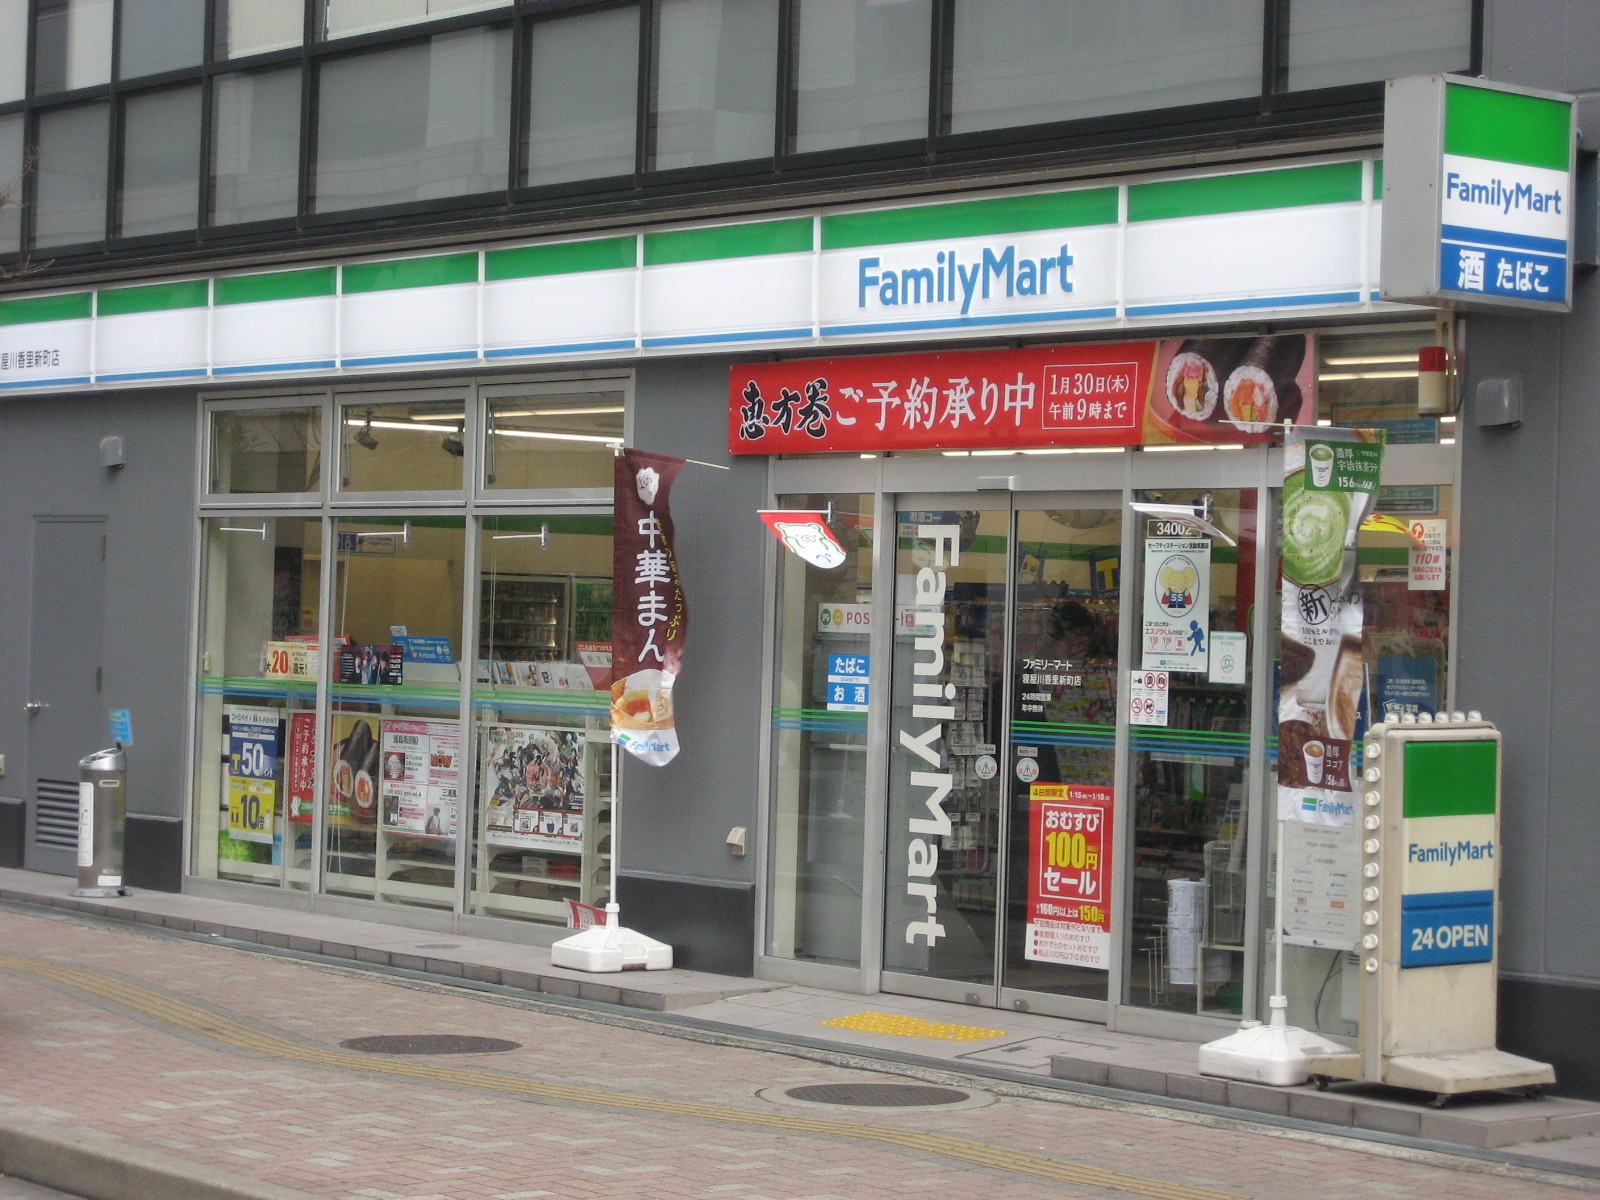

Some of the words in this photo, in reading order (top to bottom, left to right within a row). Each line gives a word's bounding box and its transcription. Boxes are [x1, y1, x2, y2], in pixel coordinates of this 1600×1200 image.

[1447, 172, 1561, 215] FamilyMart
[859, 243, 1074, 315] FamilyMart
[1458, 249, 1486, 291] 酒
[1496, 258, 1549, 292] たばこ
[1050, 373, 1131, 396] 1月30日(木)
[1049, 400, 1128, 421] 午前9時まで
[1338, 476, 1355, 488] 156
[634, 510, 671, 663] 中華まん
[1171, 593, 1183, 601] SS
[1300, 588, 1327, 622] 新
[272, 650, 289, 674] 20
[835, 657, 865, 674] たばこ
[1023, 659, 1073, 671] ファミリーマート
[1022, 692, 1052, 702] 24時間営業
[900, 525, 960, 948] FamilyMart
[1045, 809, 1099, 833] おむすび
[1045, 831, 1098, 871] 100円
[1408, 841, 1494, 867] FamilyMart
[1043, 866, 1097, 895] セール
